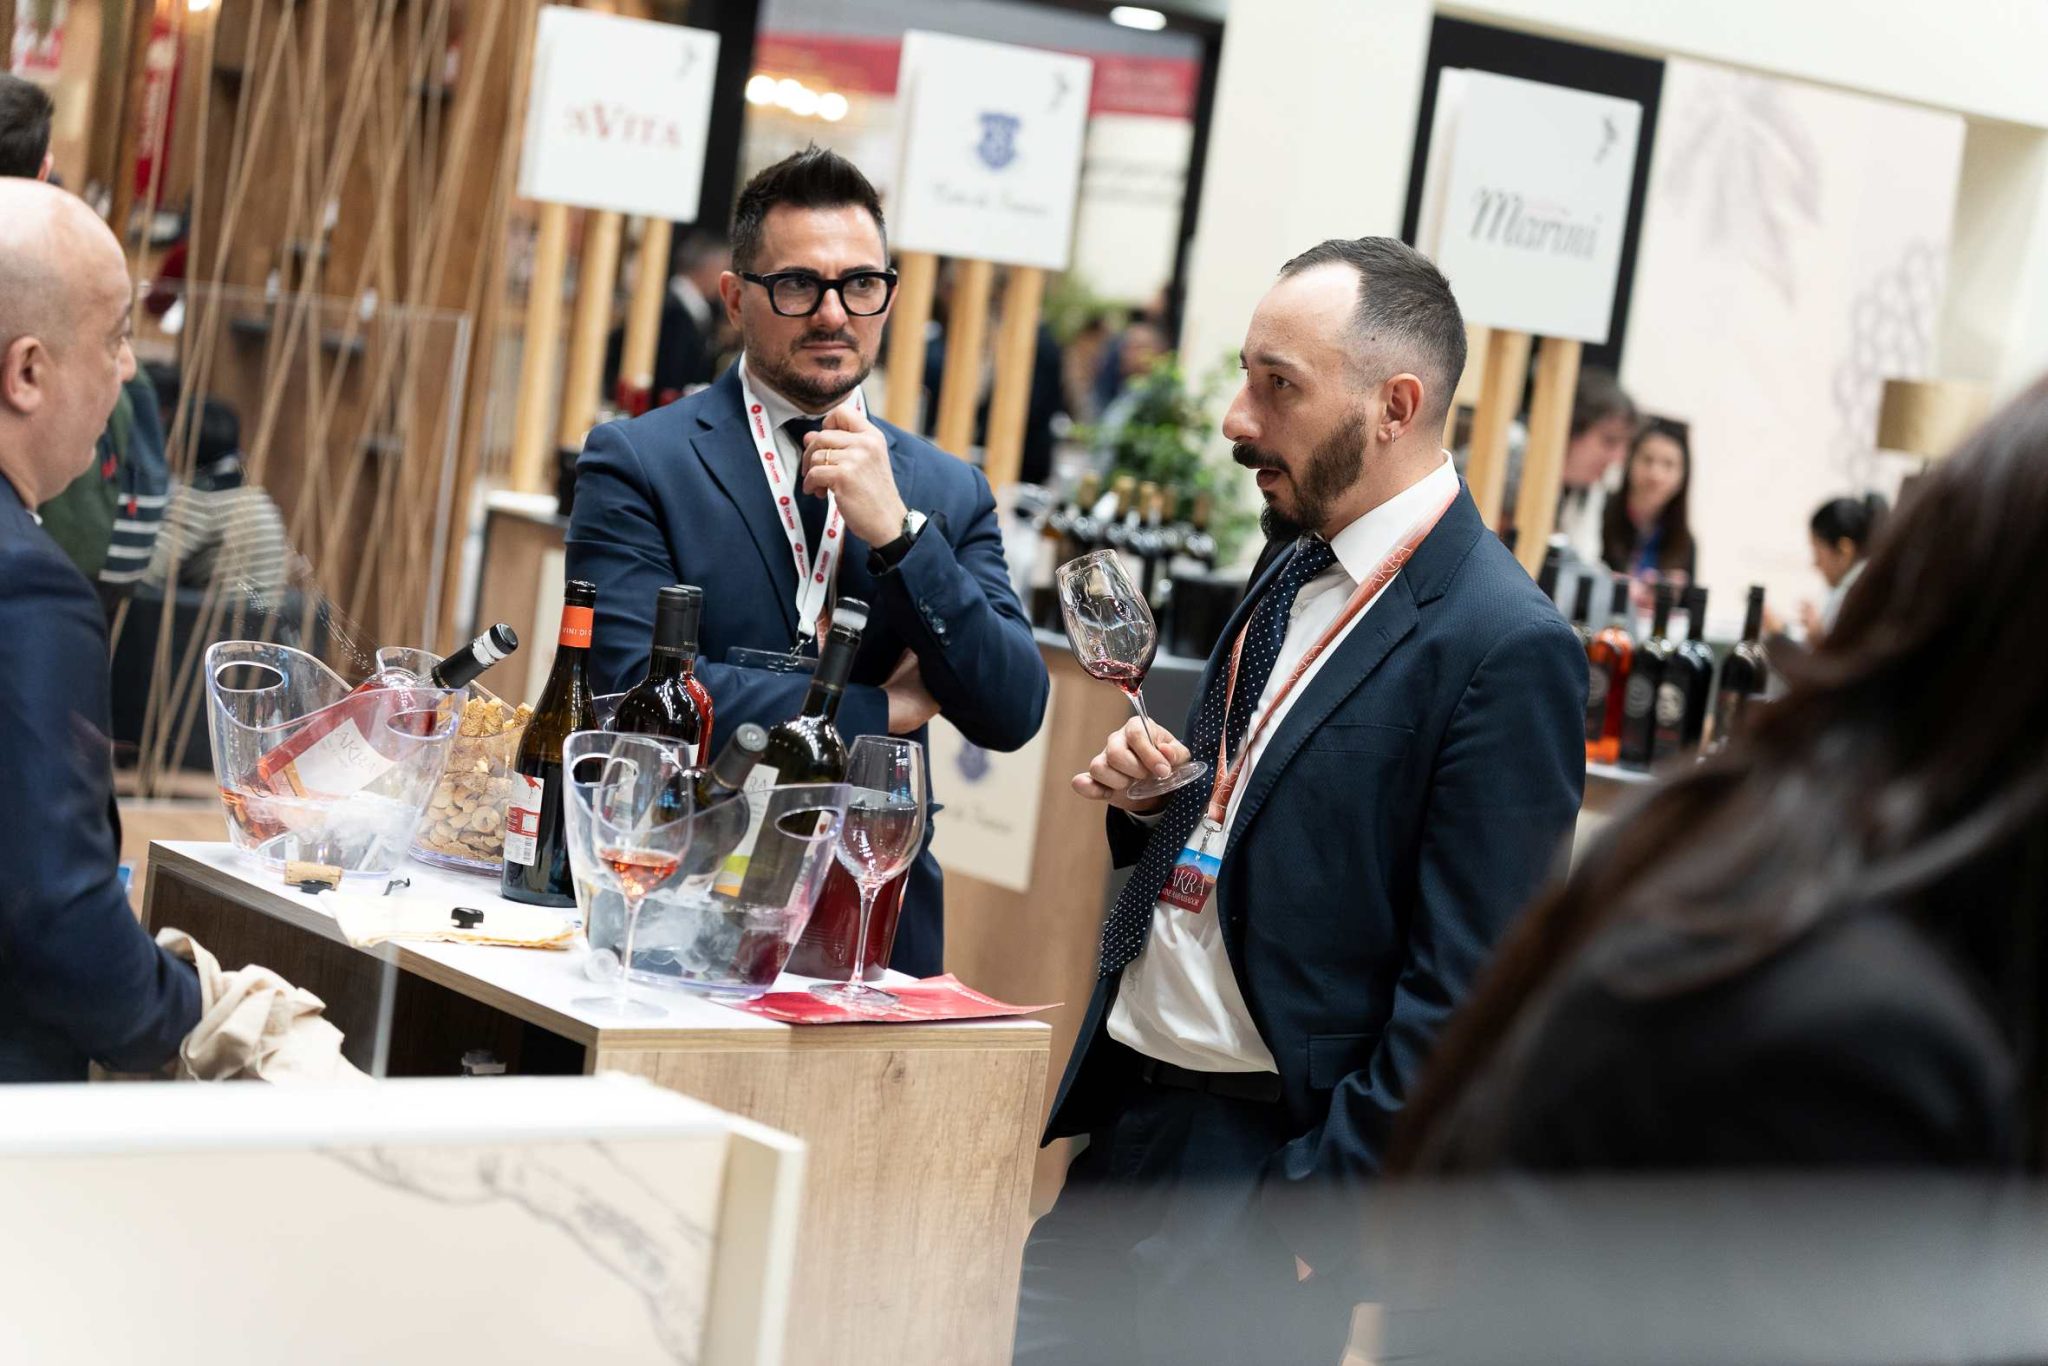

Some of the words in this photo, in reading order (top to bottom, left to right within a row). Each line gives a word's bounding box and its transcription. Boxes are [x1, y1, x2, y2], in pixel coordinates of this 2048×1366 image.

[1470, 186, 1604, 259] Marini
[1368, 545, 1413, 591] AKRA
[1167, 868, 1206, 896] AKRA
